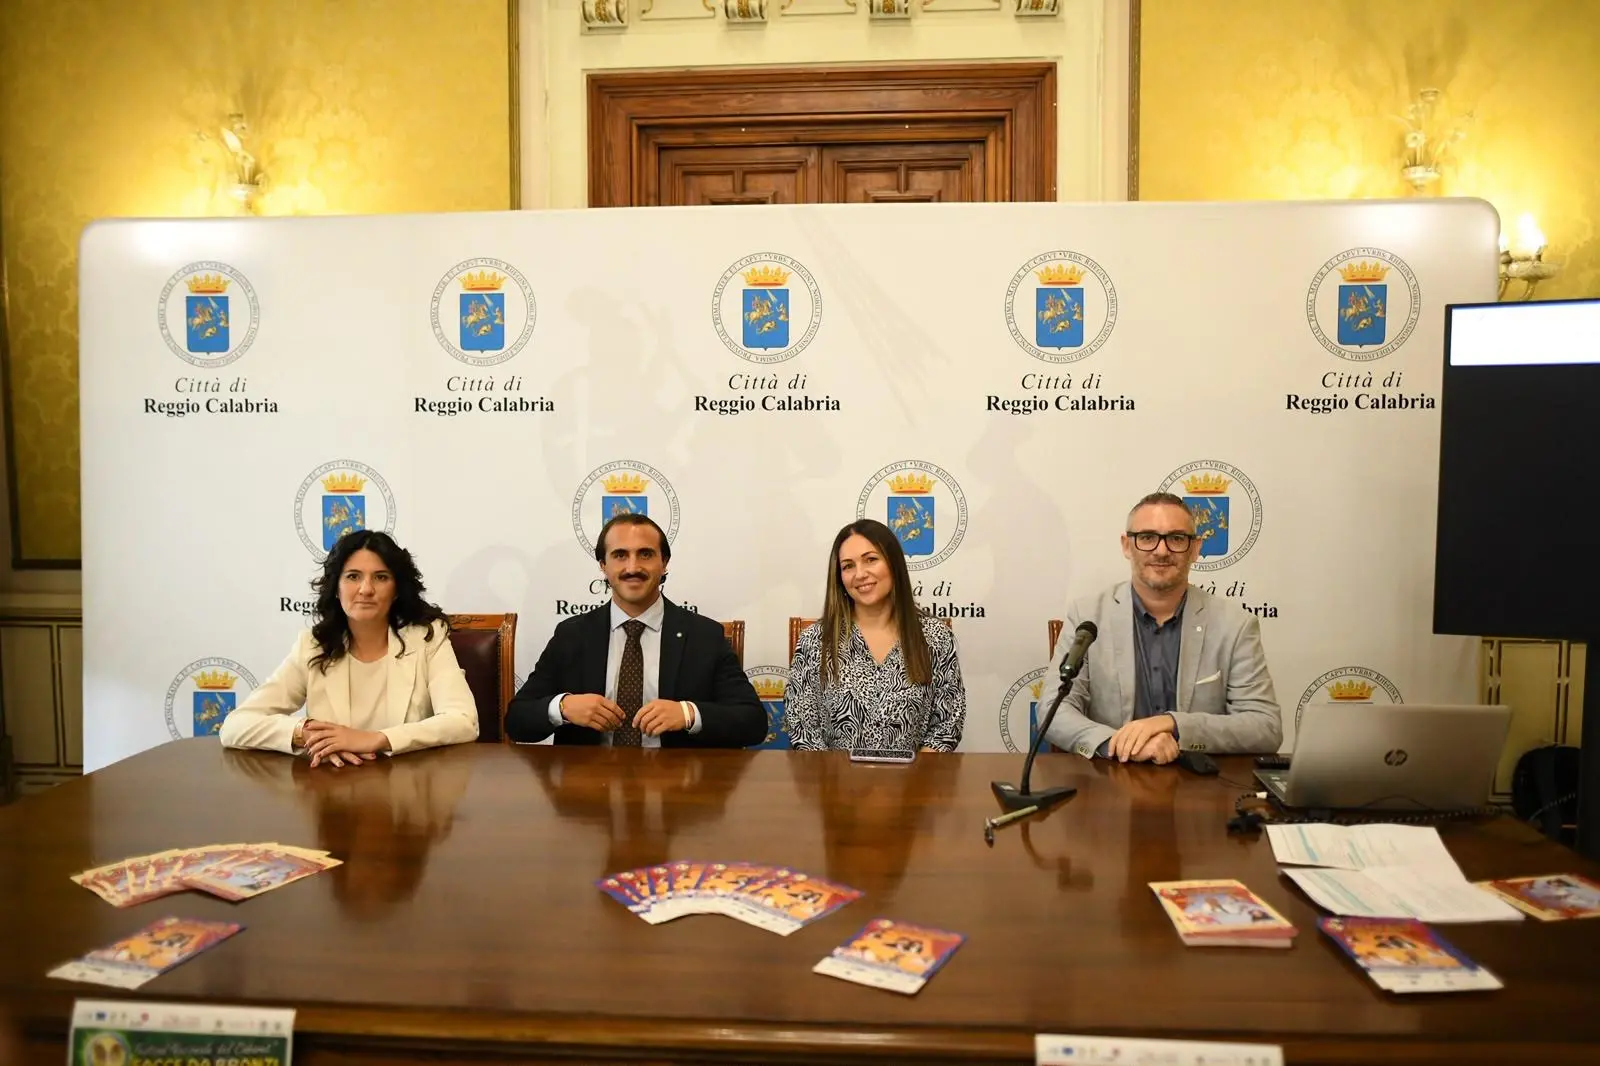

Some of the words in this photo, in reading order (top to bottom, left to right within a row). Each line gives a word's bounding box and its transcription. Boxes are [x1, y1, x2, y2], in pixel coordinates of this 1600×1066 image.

[175, 377, 220, 393] Città
[229, 377, 247, 393] di
[447, 376, 494, 391] Città
[503, 376, 522, 391] di
[728, 373, 778, 390] Città
[788, 373, 807, 390] di
[1021, 373, 1072, 390] Città
[1082, 373, 1101, 390] di
[1321, 371, 1372, 388] Città
[1382, 371, 1402, 388] di
[144, 398, 200, 418] Reggio
[205, 398, 278, 413] Calabria
[415, 397, 472, 416] Reggio
[478, 396, 554, 412] Calabria
[695, 395, 755, 416] Reggio
[761, 395, 840, 411] Calabria
[986, 395, 1048, 415] Reggio
[1055, 395, 1135, 411] Calabria
[1286, 393, 1348, 414] Reggio
[1354, 393, 1435, 410] Calabria
[933, 581, 952, 597] di
[1226, 581, 1245, 597] di
